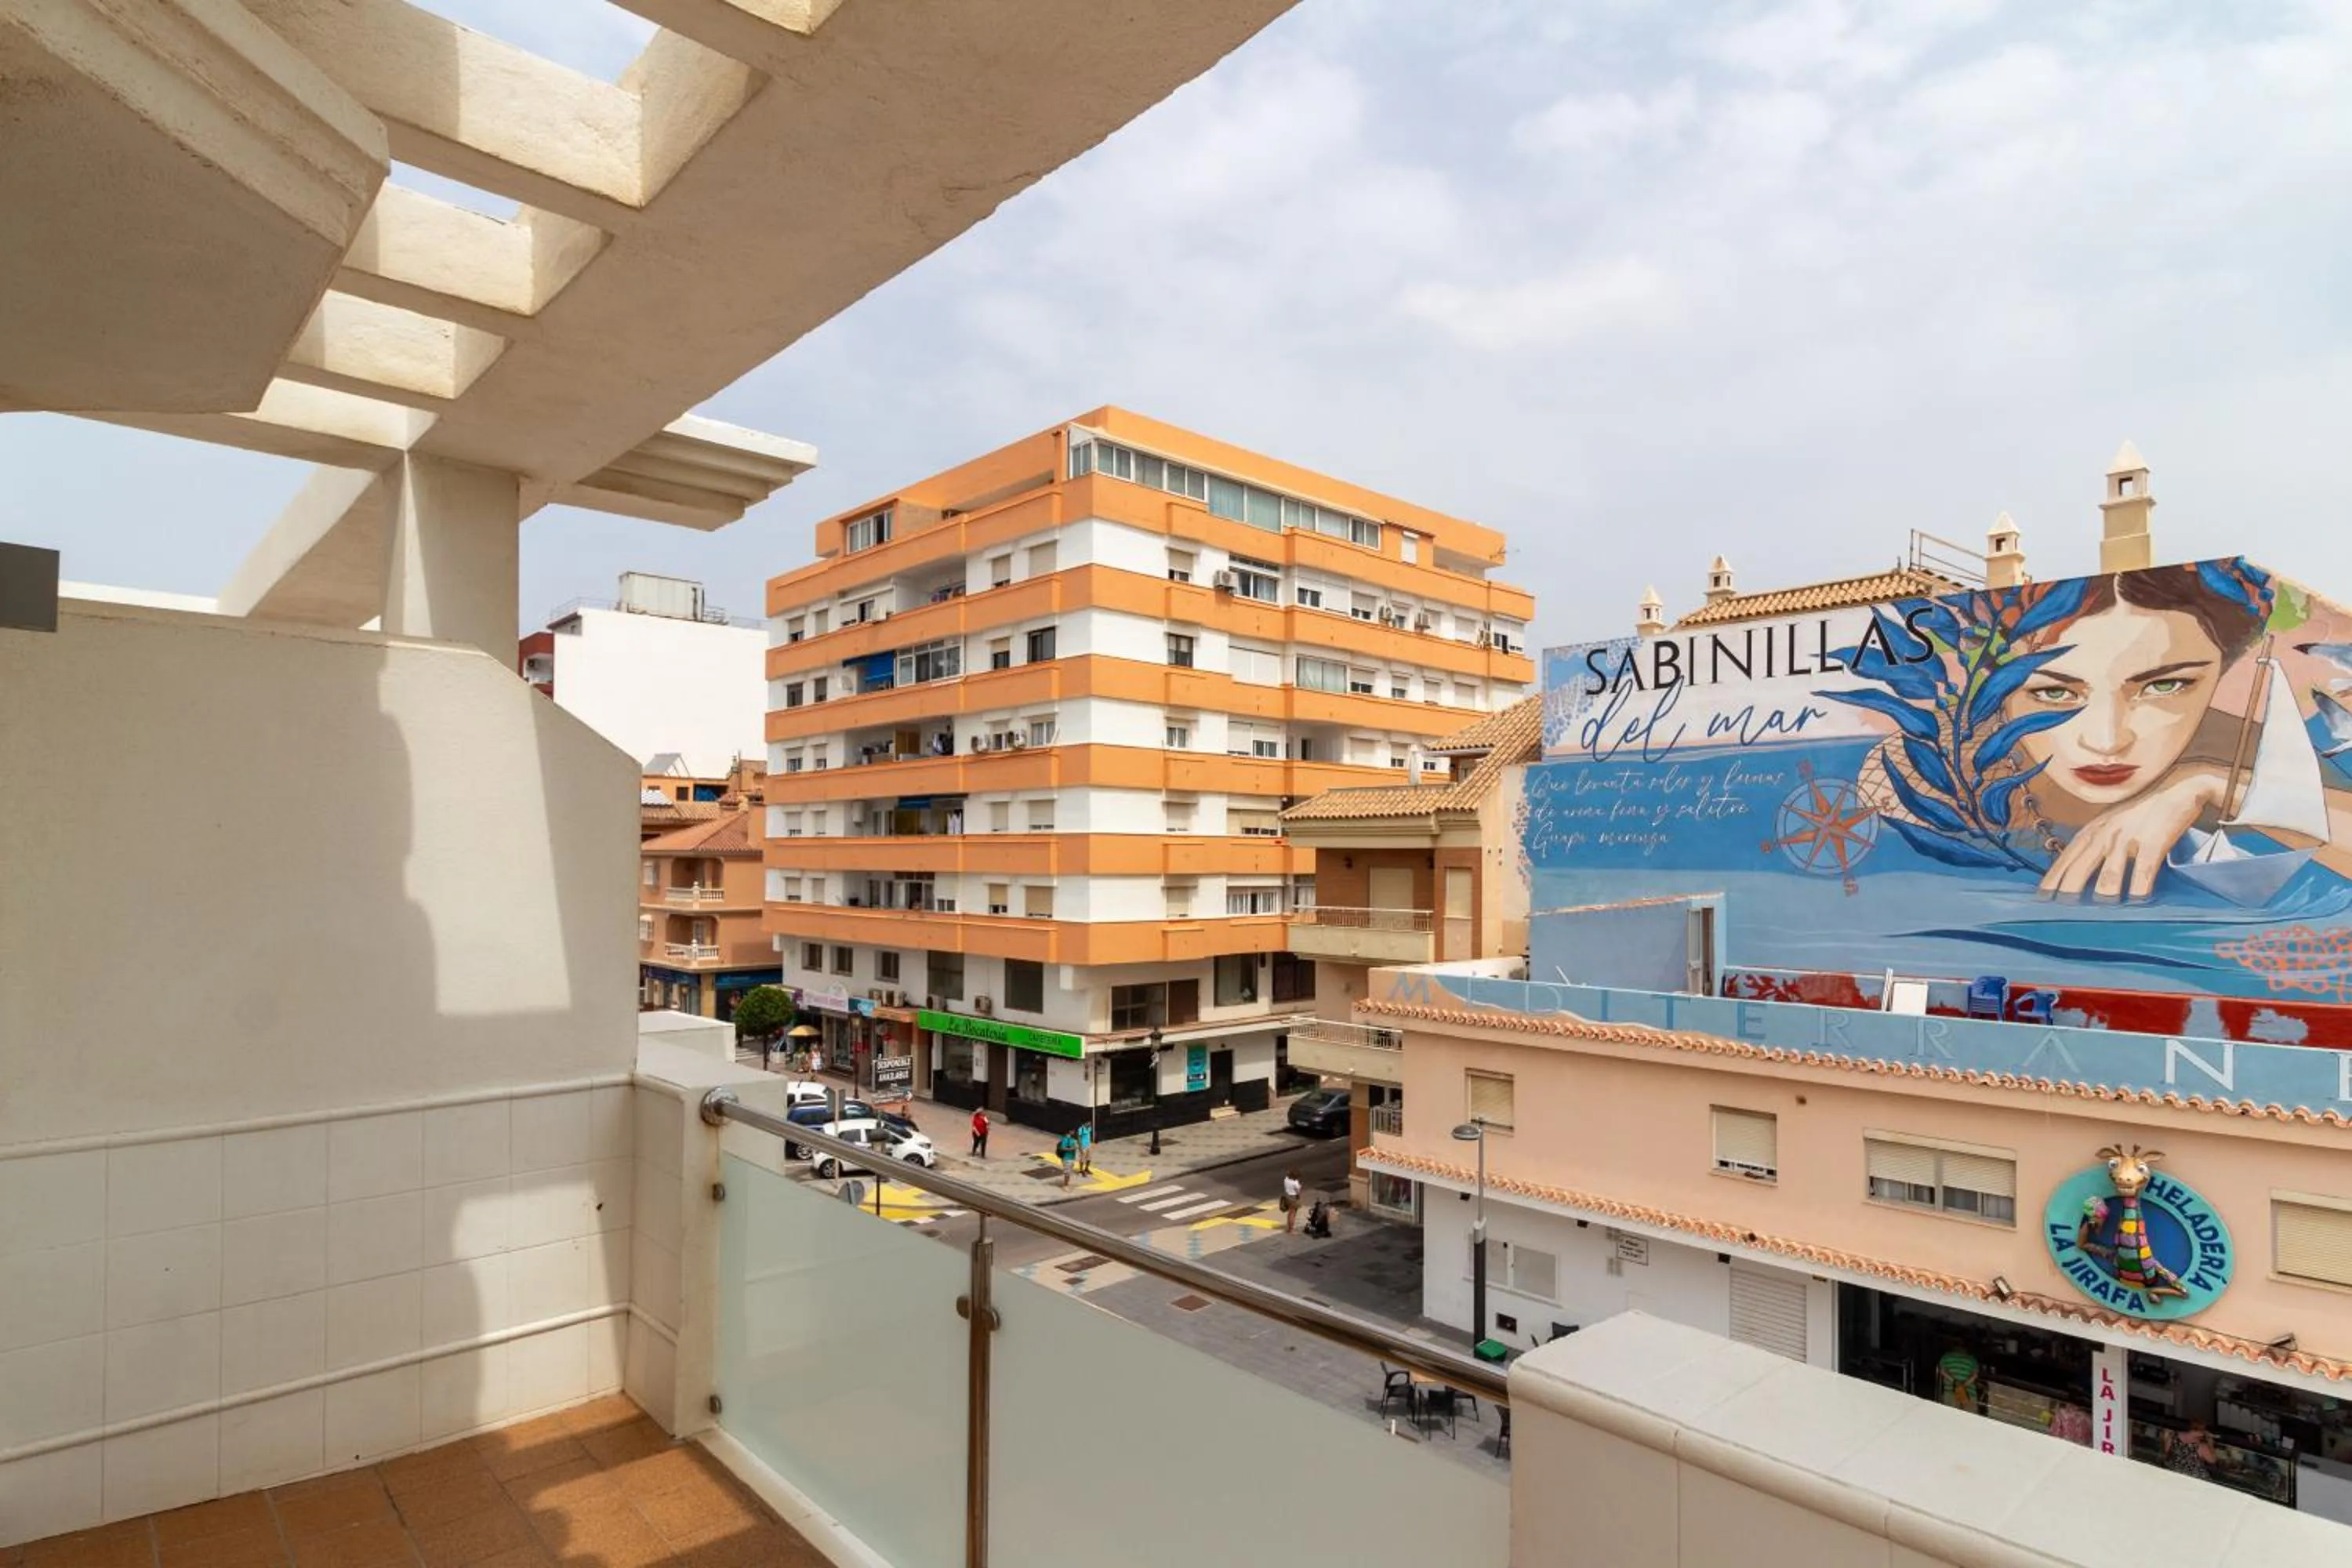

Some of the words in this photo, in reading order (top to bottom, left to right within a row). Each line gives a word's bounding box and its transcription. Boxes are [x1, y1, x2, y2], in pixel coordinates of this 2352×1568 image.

[1584, 607, 1935, 696] SABINILLAS
[1581, 675, 1686, 764] del
[1707, 705, 1828, 747] mar
[2049, 1223, 2076, 1252] LA
[2144, 1175, 2228, 1292] HELADERÍA
[2061, 1257, 2146, 1312] JIRAFA
[2100, 1367, 2115, 1401] LA
